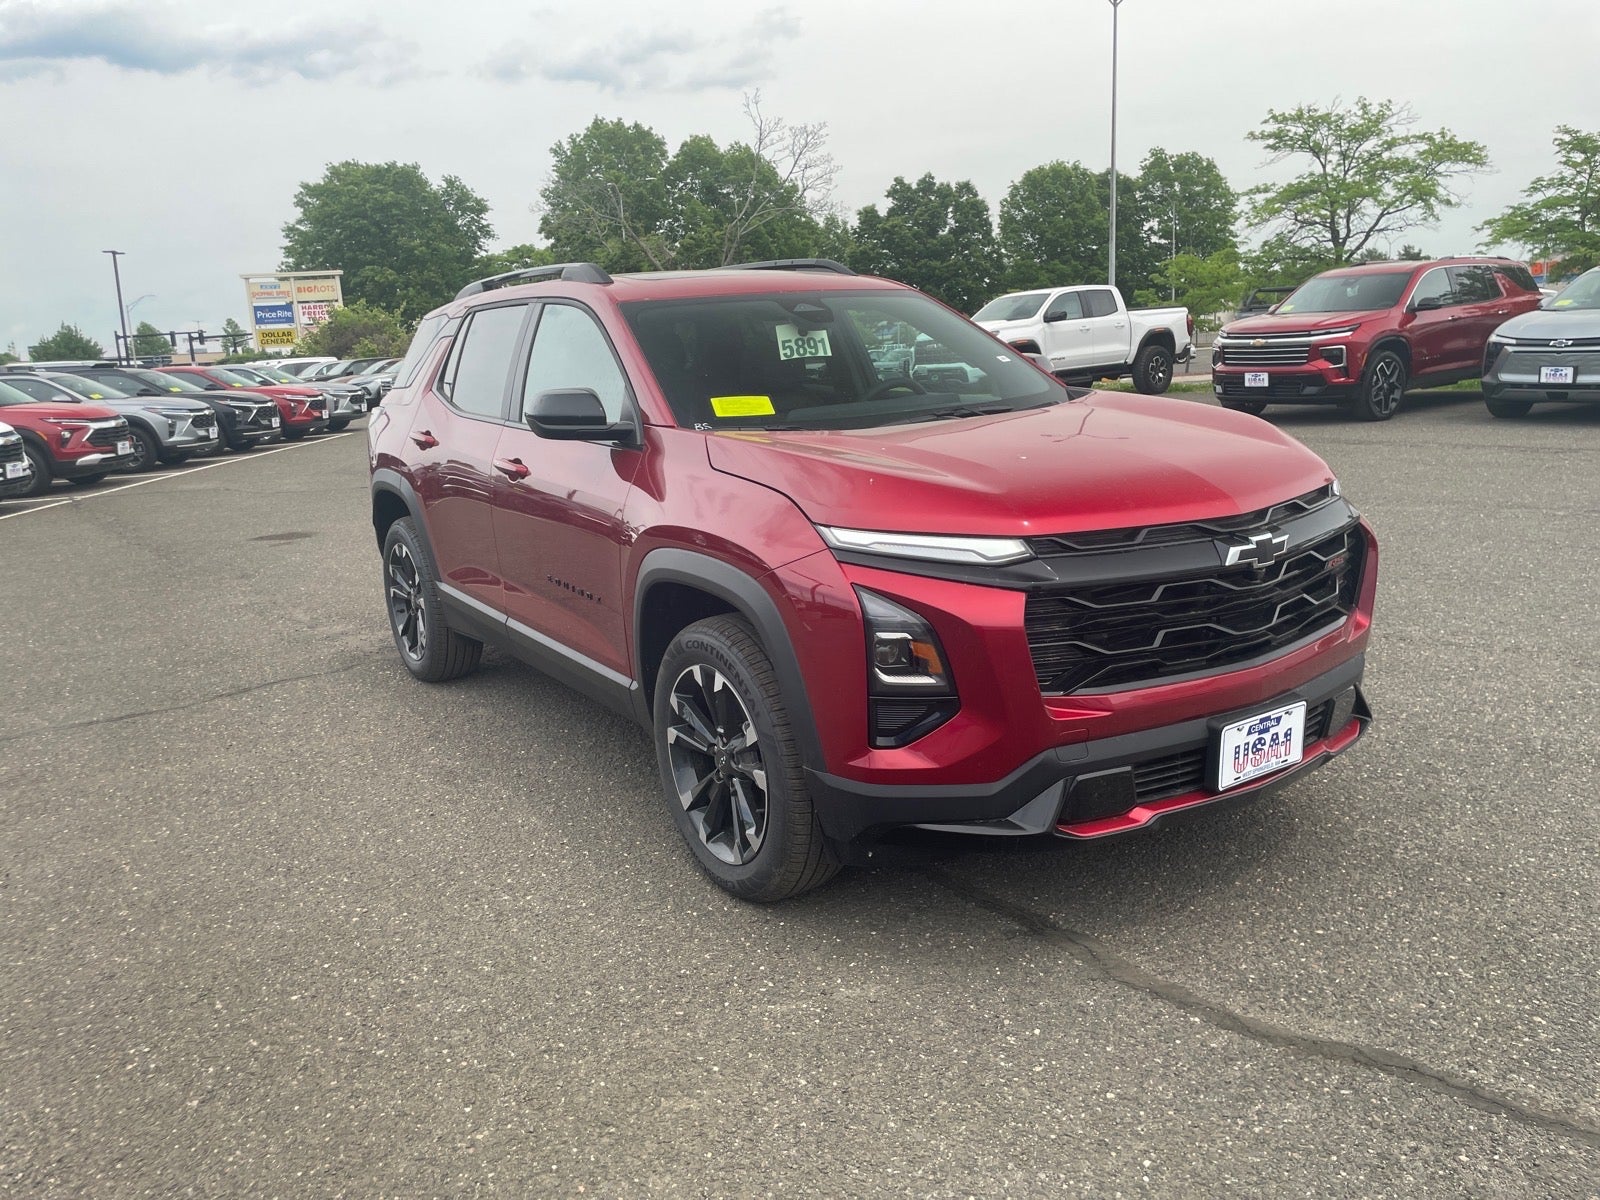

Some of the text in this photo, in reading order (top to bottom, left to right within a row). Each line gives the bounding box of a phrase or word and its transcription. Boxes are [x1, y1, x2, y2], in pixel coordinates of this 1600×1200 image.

[257, 309, 293, 319] Price Rite
[781, 337, 828, 359] 5891
[1250, 718, 1279, 733] CENTRAL
